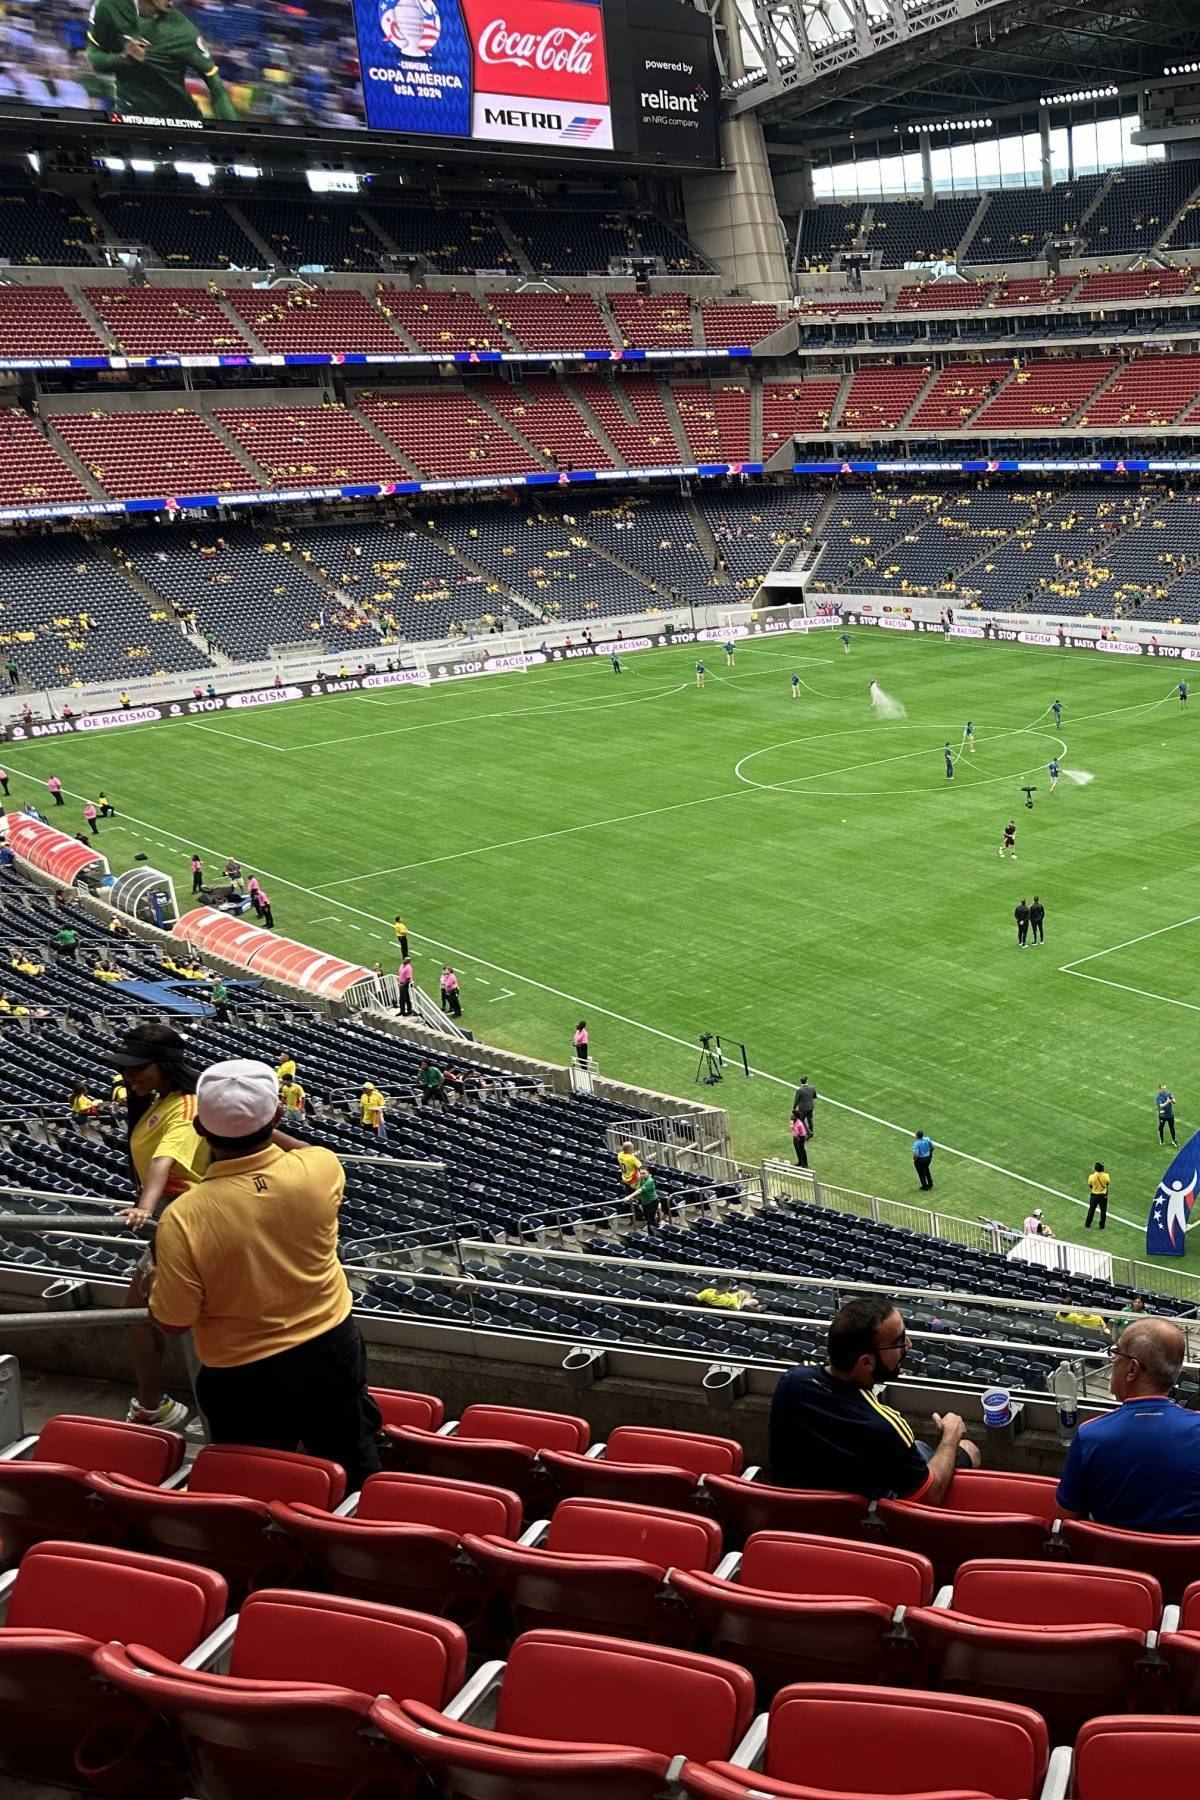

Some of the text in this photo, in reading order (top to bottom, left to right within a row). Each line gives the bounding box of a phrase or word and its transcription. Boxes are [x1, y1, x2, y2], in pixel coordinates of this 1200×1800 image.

[478, 19, 597, 75] Coca-Cola
[645, 60, 693, 75] powered by
[369, 67, 463, 89] COPA AMERICA
[394, 84, 442, 99] USA 2024
[641, 89, 699, 112] reliant
[122, 115, 203, 129] MITSUBISHI ELECTRIC
[484, 108, 562, 130] METRO
[651, 115, 668, 125] NRG
[668, 117, 699, 129] company
[765, 622, 788, 631] BASTA
[860, 617, 907, 628] STOP RACISM
[671, 633, 695, 643] STOP
[998, 631, 1051, 643] STOP RACISM
[566, 647, 593, 658] BASTA
[613, 640, 648, 652] RACISMO
[1074, 639, 1140, 652] BASTA DE RACISMO
[1159, 647, 1180, 657] STOP
[453, 656, 533, 674] STOP RACISM
[326, 670, 426, 693] BASTA DE RACISMO
[189, 691, 287, 713] STOP RACISM
[32, 710, 155, 736] BASTA DE RACISMO
